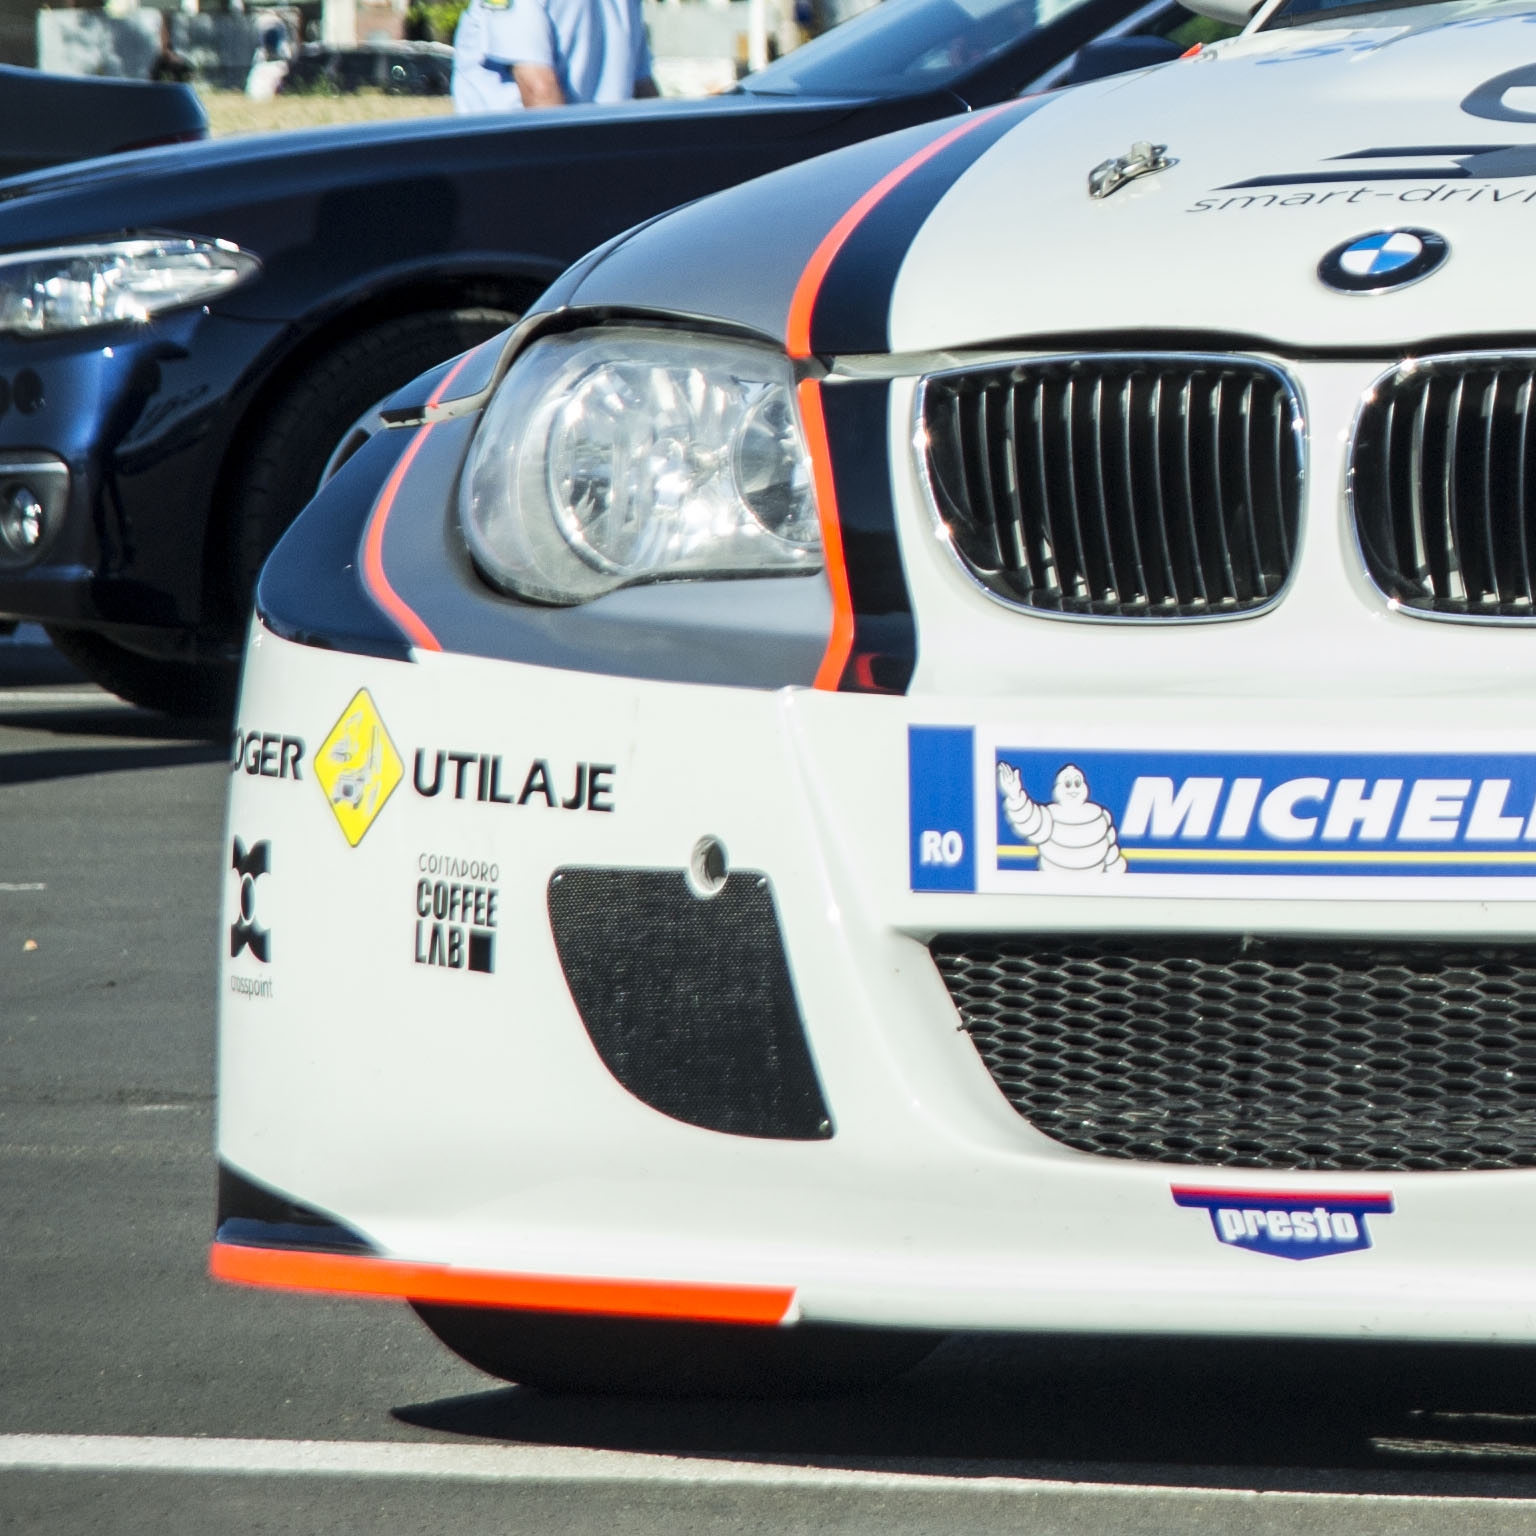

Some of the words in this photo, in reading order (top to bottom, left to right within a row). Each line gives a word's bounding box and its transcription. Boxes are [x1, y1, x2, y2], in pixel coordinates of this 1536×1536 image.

[412, 746, 617, 813] UTILAJE
[921, 831, 963, 866] RO
[419, 853, 499, 882] COSTADORO
[416, 878, 499, 927] COFFEE
[415, 919, 465, 969] LAB
[230, 973, 273, 1000] crosspoint
[1217, 1207, 1359, 1242] presto
